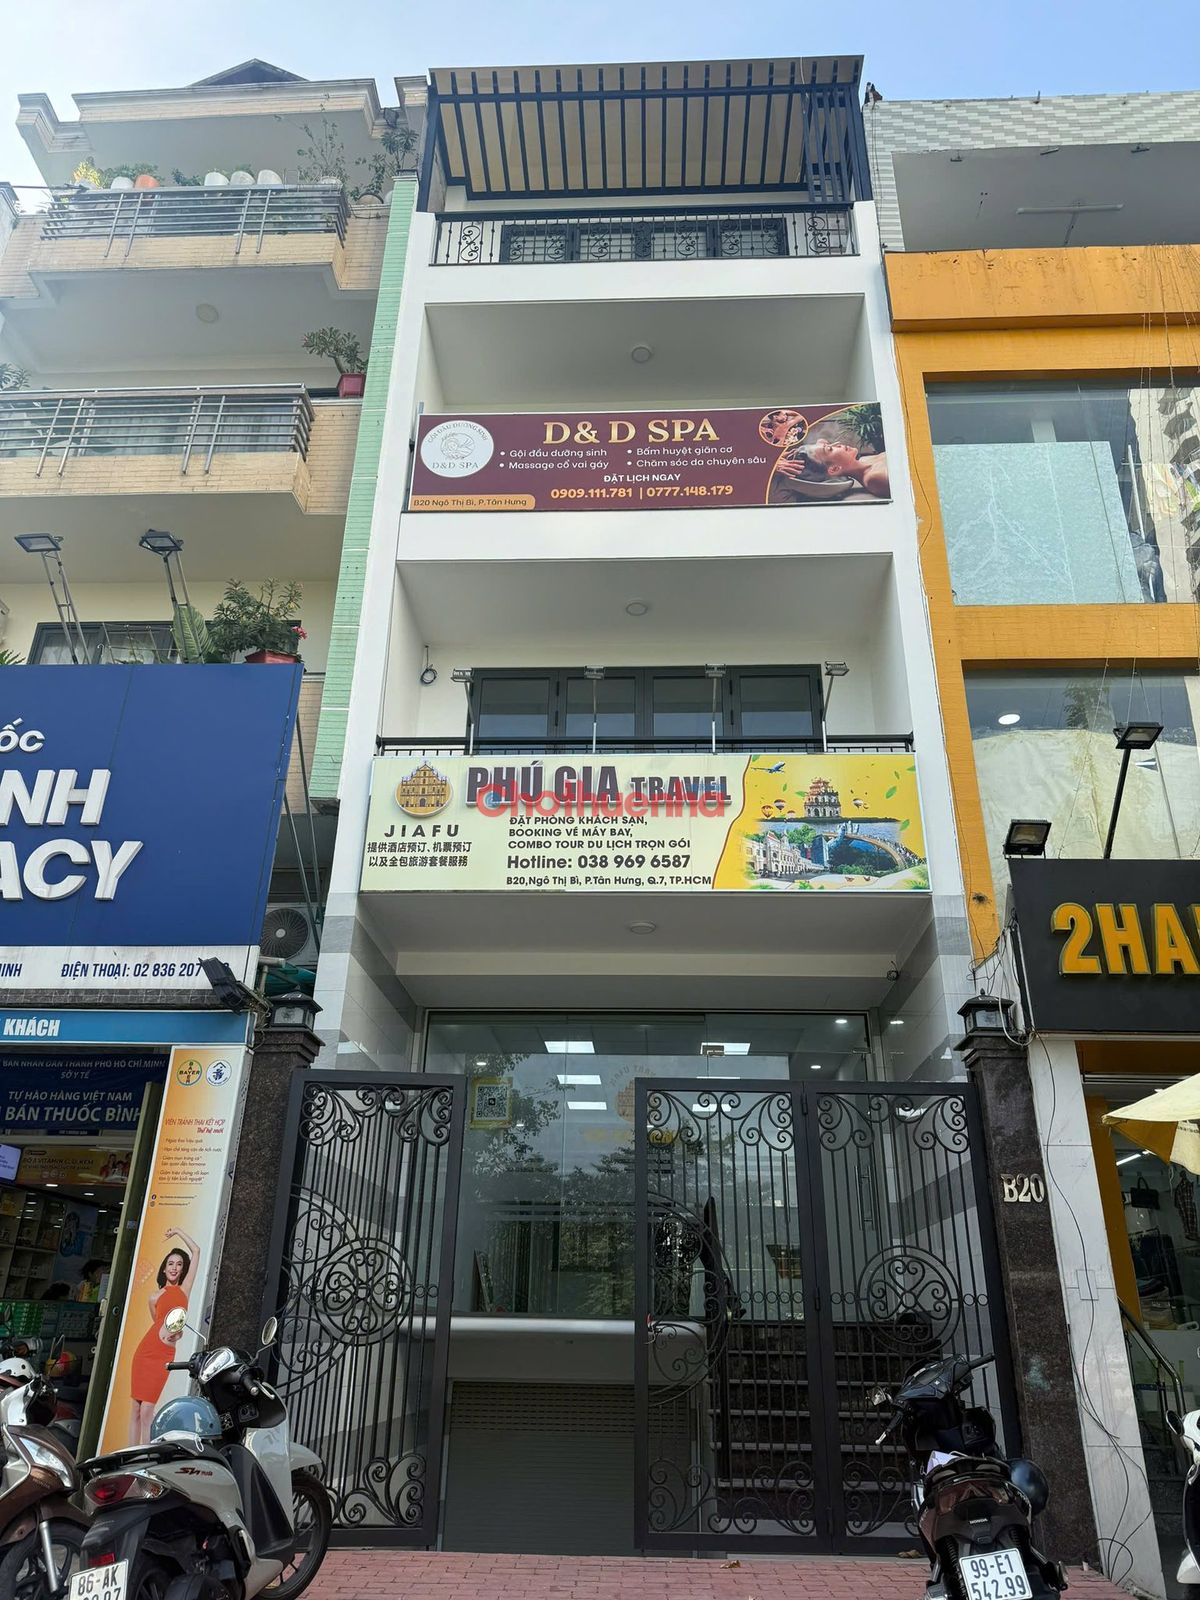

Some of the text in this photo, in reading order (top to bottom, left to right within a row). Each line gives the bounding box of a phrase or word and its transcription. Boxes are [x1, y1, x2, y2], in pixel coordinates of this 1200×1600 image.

[648, 418, 720, 443] SPA
[510, 450, 526, 459] Gội
[551, 449, 584, 458] dưỡng
[637, 447, 660, 456] Bấm
[663, 446, 692, 456] huyệt
[509, 462, 554, 470] Massage
[557, 459, 570, 468] cổ
[590, 460, 609, 470] gáy
[637, 455, 767, 467] Chăm sóc da chuyên sâu
[604, 473, 681, 484] ĐẶT LỊCH NGAY
[550, 485, 734, 498] 0909.111.781 0777.148.179
[432, 498, 449, 508] Ngô
[451, 498, 464, 508] Thị
[505, 498, 527, 507] Hưng
[466, 760, 732, 806] PHÚ GIA TRAVEL
[510, 814, 648, 827] ĐẶT PHÒNG KHÁCH SẠN,
[384, 825, 459, 838] JIAFU
[509, 828, 562, 837] BOOKING
[582, 826, 607, 837] MÁY
[610, 828, 633, 838] BAY,
[508, 838, 690, 851] COMBO TOUR DU LỊCH TRỌN GÓI
[507, 854, 691, 869] Hotline: 038 969 6587
[553, 876, 567, 887] Thị
[585, 876, 611, 885] P.Tân
[614, 876, 644, 887] Hưng,
[648, 876, 667, 886] Q.7,
[670, 875, 711, 885] TP.HCM
[61, 960, 90, 980] ĐIỆN
[133, 963, 149, 977] 02
[152, 963, 176, 977] 836
[179, 963, 202, 977] 207
[3, 1016, 60, 1037] KHÁCH
[50, 1090, 80, 1101] HÀNG
[83, 1091, 105, 1103] VIỆT
[107, 1092, 132, 1101] NAM
[5, 1104, 39, 1121] BÁN
[43, 1102, 102, 1121] THUỐC
[1001, 1173, 1045, 1203] B20
[970, 1554, 1014, 1579] 99-E1
[77, 1565, 119, 1596] 86-AK
